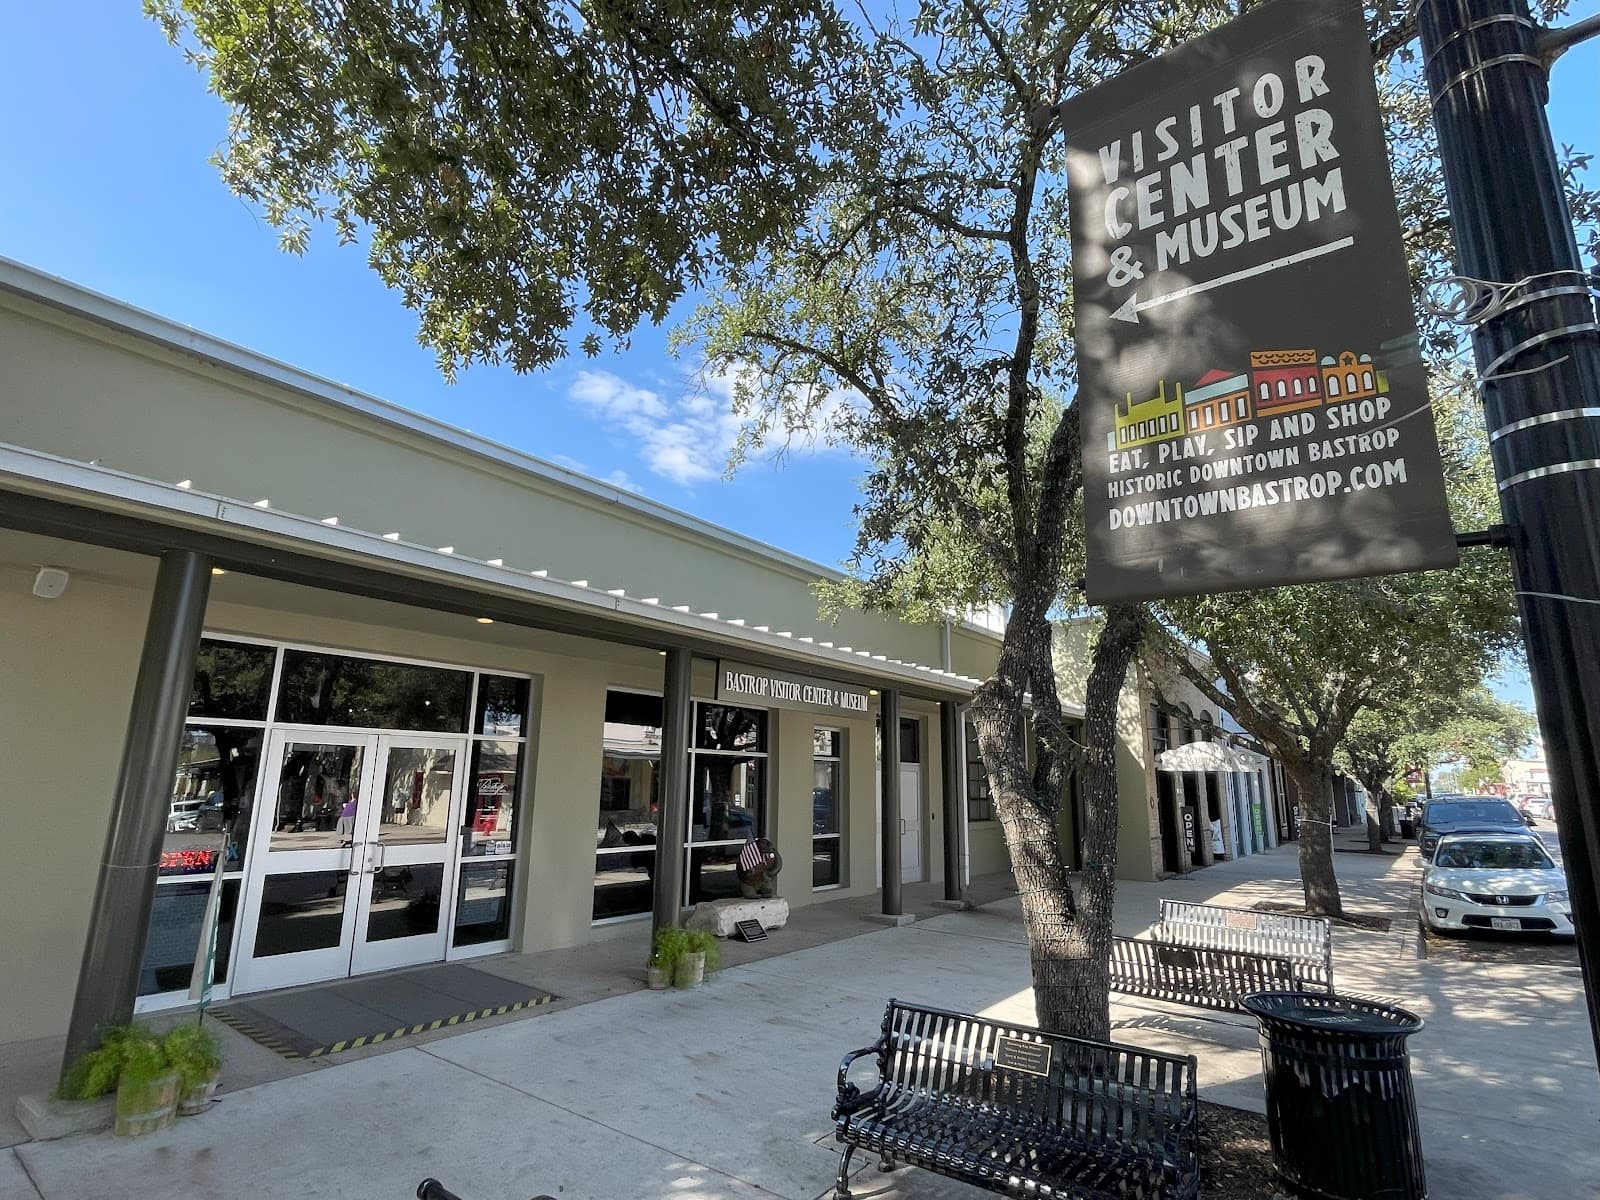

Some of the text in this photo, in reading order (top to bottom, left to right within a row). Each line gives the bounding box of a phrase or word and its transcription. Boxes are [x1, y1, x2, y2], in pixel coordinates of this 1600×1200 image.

[1099, 55, 1331, 184] VISITOR
[1104, 108, 1340, 240] CENTER
[1106, 167, 1347, 288] & MUSEUM
[1108, 427, 1400, 499] HISTORIC DOWNTOWN BASTROP
[1109, 397, 1392, 474] EAT, PLAY, SIP AND SHOP
[1109, 458, 1408, 531] DOWNTOWNBASTROP.COM
[726, 672, 868, 712] BASTROP VISITOR CENTER & MUSEUM
[1183, 813, 1194, 847] OPEN
